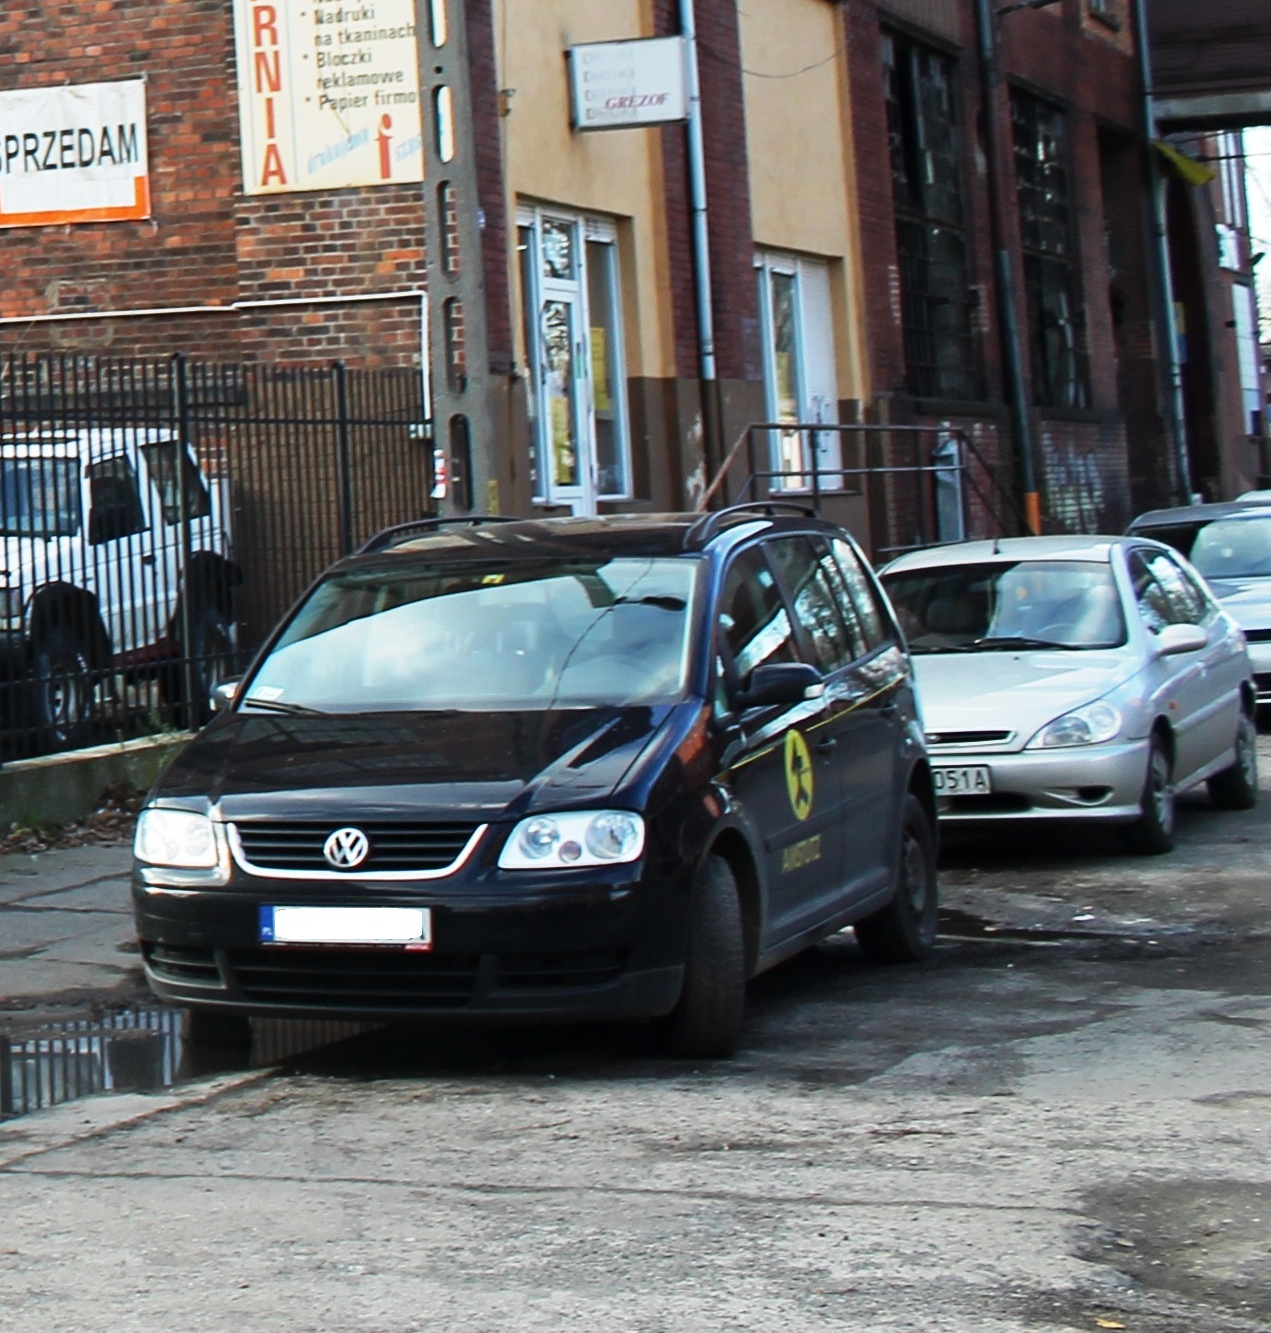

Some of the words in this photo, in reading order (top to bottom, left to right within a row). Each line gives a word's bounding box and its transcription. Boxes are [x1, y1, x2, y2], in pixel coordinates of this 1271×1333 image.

[314, 3, 375, 24] Nadruki
[314, 32, 332, 45] na
[337, 22, 416, 44] tkaninach
[316, 47, 372, 67] Bloczki
[317, 69, 404, 88] reklamowe
[318, 92, 368, 110] Papier
